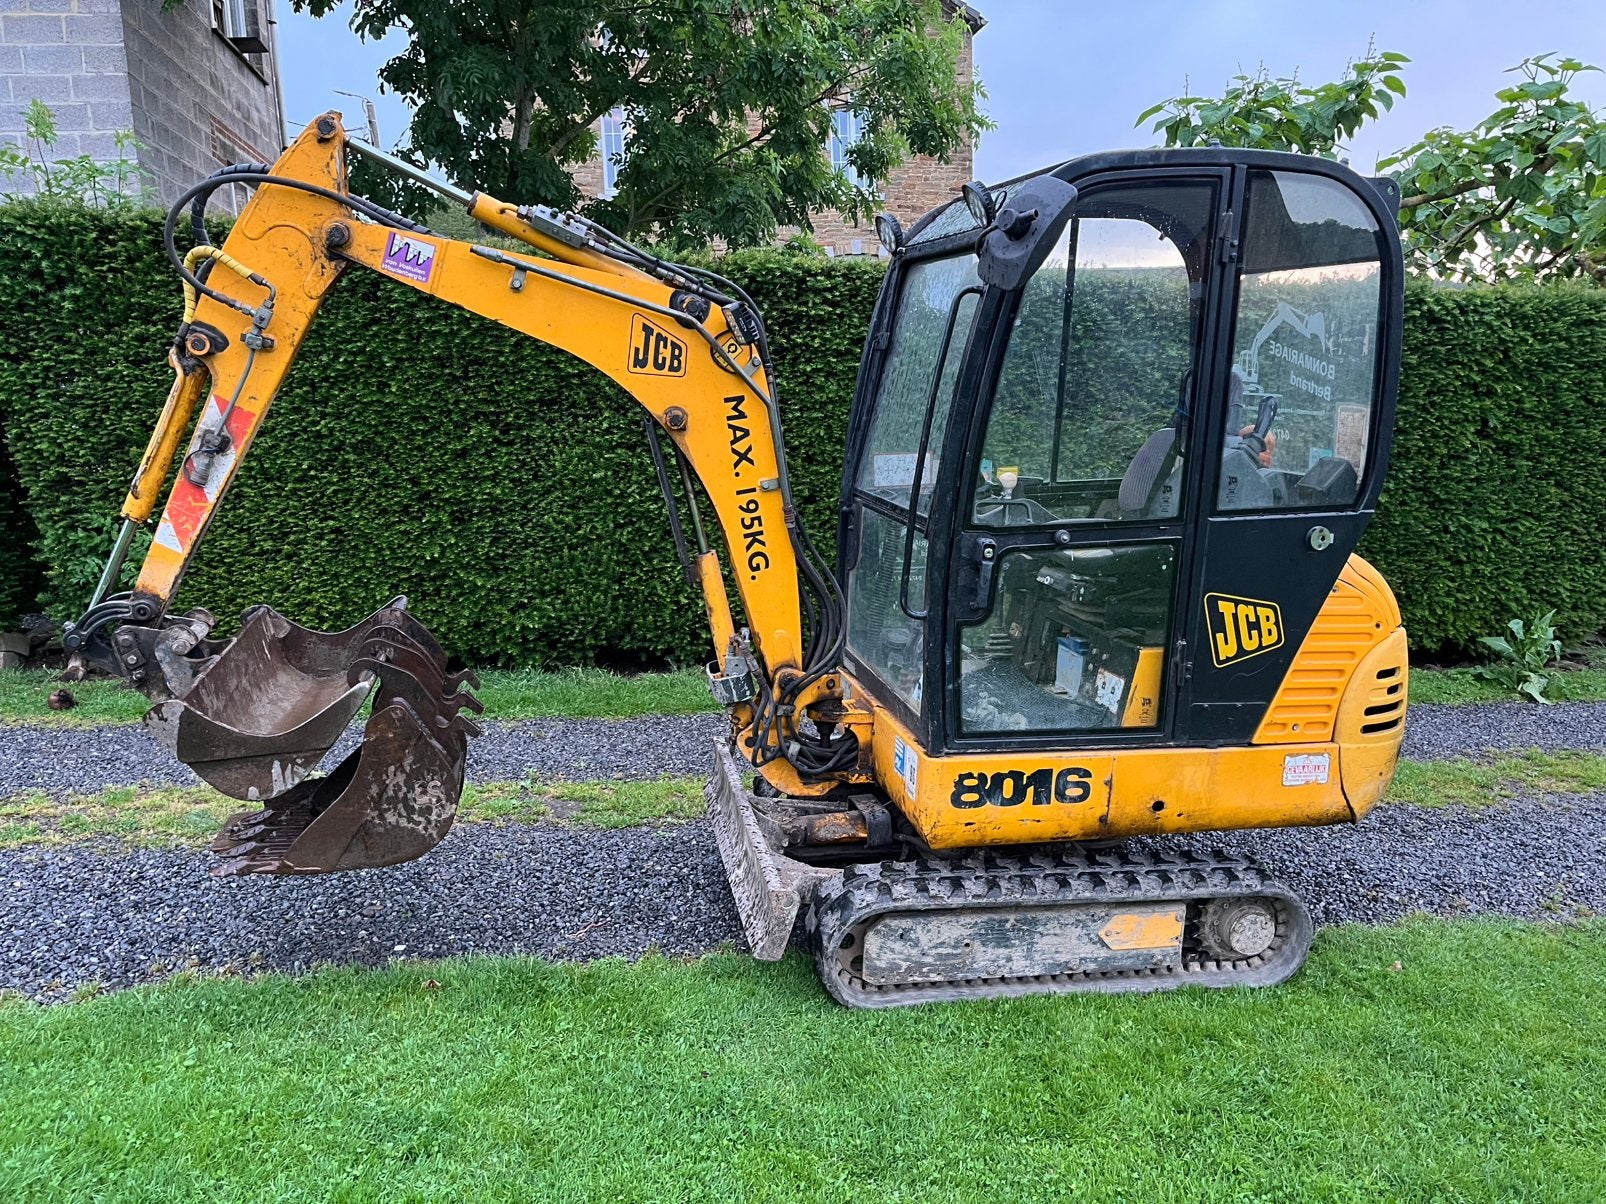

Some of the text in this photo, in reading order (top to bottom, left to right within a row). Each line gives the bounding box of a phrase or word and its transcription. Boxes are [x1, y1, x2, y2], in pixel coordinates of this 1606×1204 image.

[633, 322, 683, 373] JCB
[723, 394, 770, 581] MAX. 195KG.
[1215, 600, 1278, 660] JCB
[950, 767, 1093, 809] 8016
